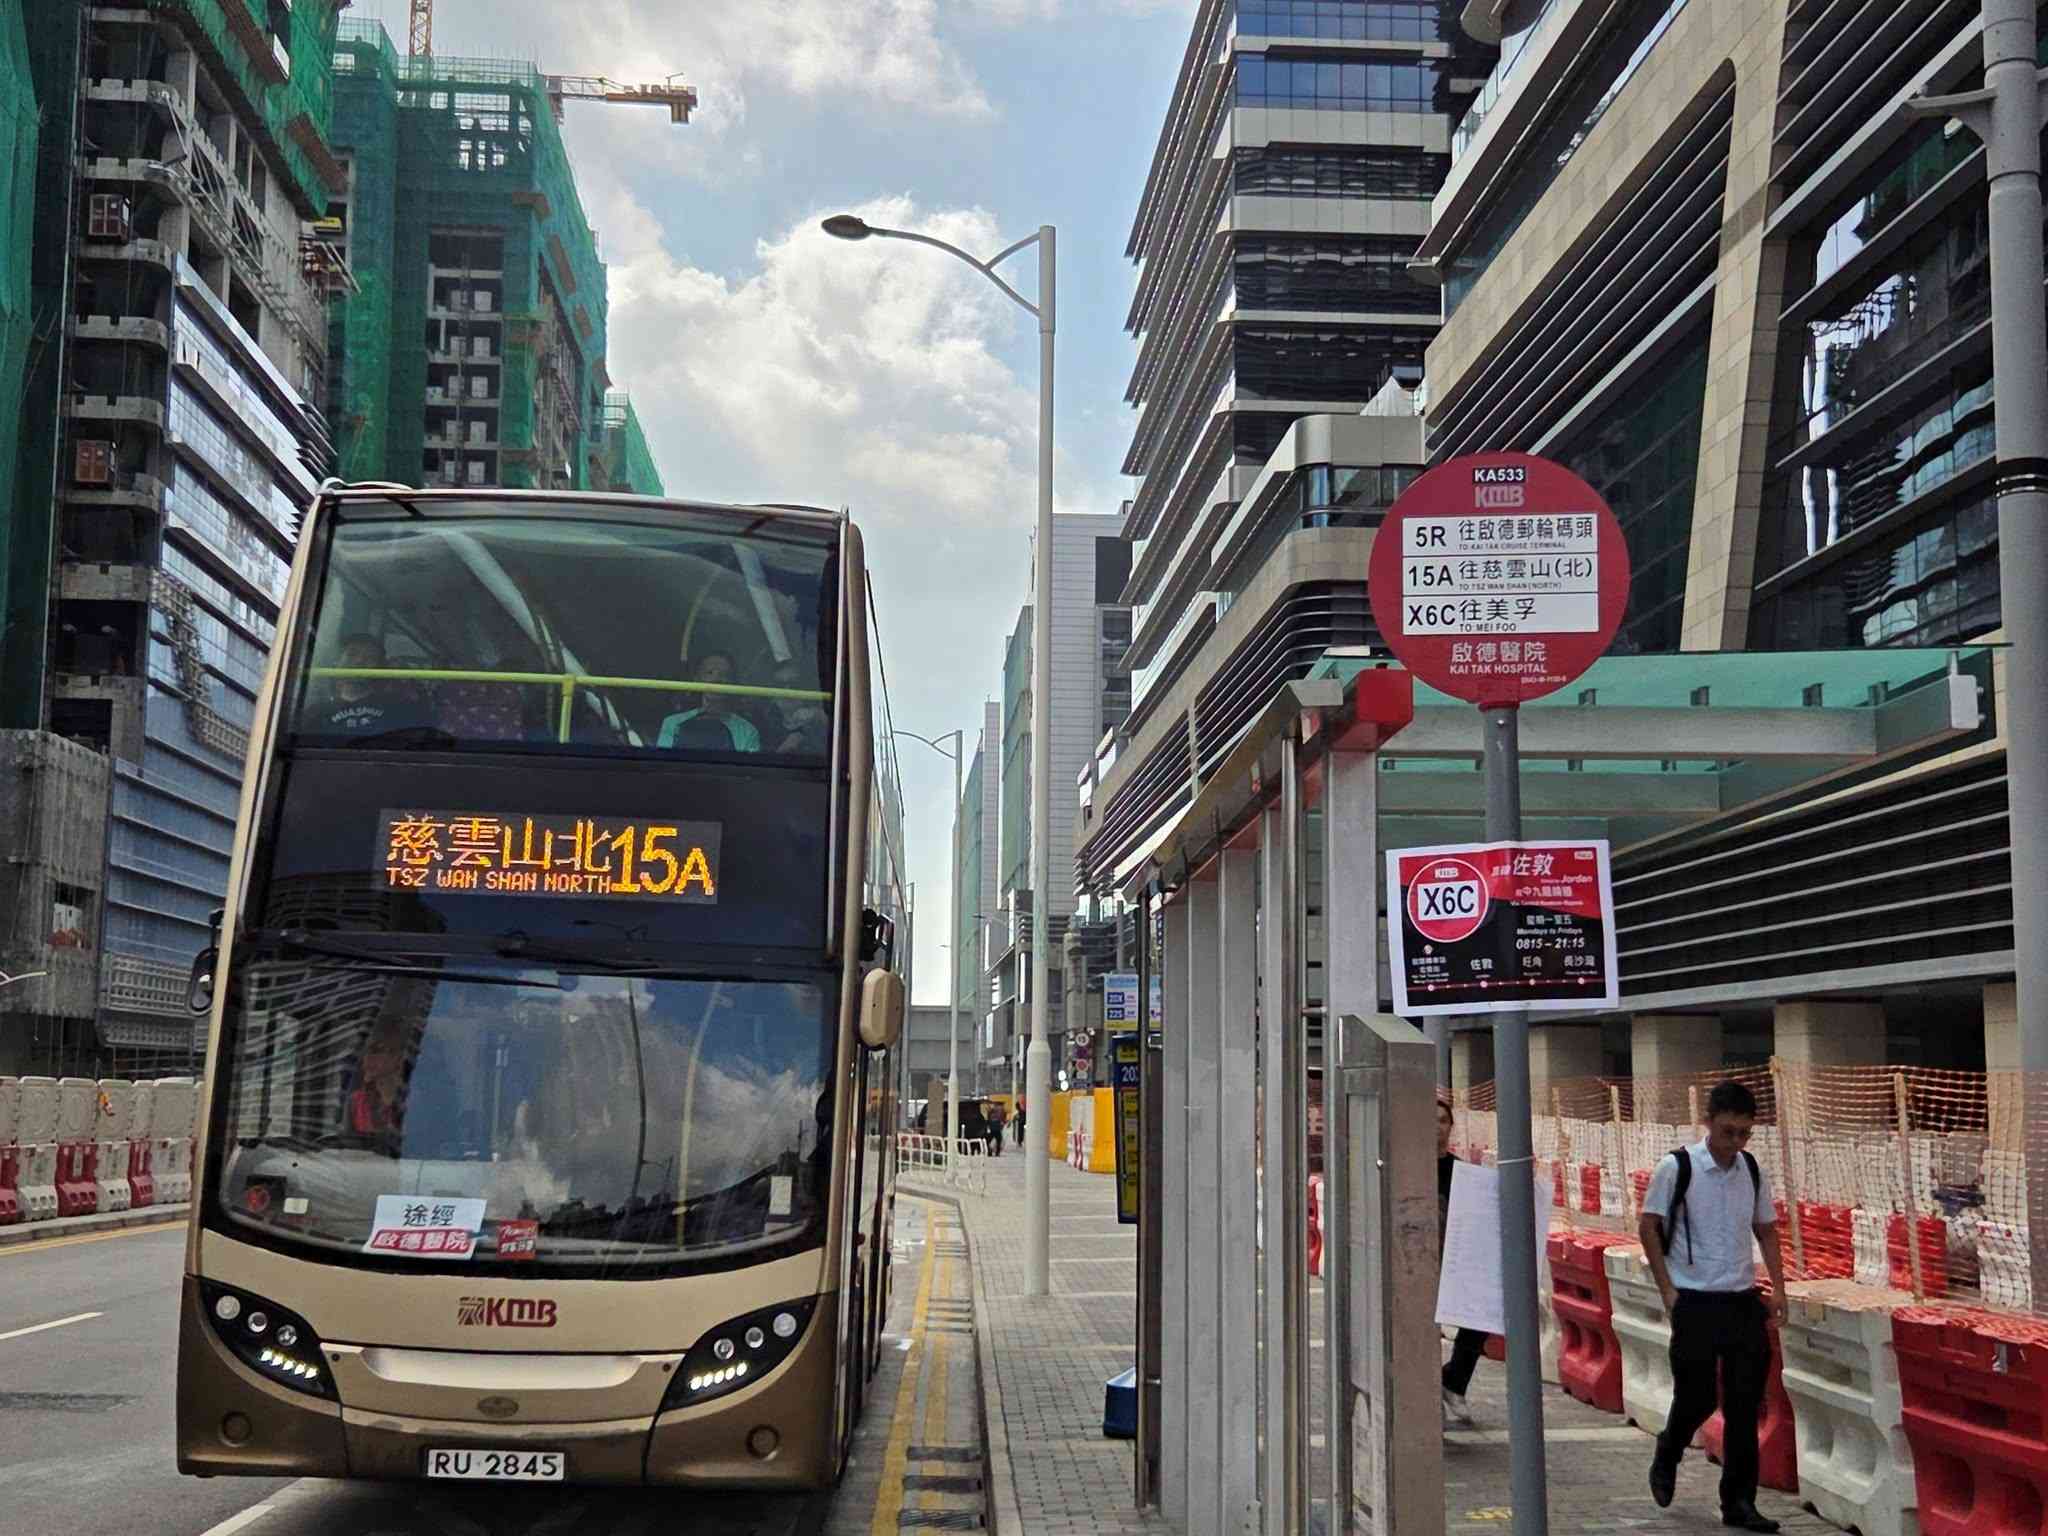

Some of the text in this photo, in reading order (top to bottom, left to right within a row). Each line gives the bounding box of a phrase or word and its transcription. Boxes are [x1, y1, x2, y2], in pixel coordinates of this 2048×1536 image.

[1474, 468, 1525, 482] KA533
[1474, 486, 1525, 508] KMB
[1415, 526, 1447, 548] 5R
[1458, 517, 1593, 541] 往啟德郵輪碼頭
[1408, 565, 1453, 587] 15A
[1458, 558, 1593, 580] 往慈雲山(北)
[1408, 604, 1456, 626] X6C
[1459, 598, 1537, 621] 往美孚
[1460, 623, 1517, 632] TO MEI FOO
[1452, 641, 1547, 662] 啟德醫院
[1450, 663, 1548, 674] KAI TAK HOSPITAL
[387, 812, 714, 895] 慈雲山北 15A
[1513, 854, 1554, 876] 佐敦
[386, 867, 612, 894] TSZ WAN SHAN NORTH
[1423, 886, 1475, 915] X6C
[1121, 1066, 1138, 1082] 20
[403, 1203, 456, 1226] 途經
[486, 1297, 557, 1328] KMB
[434, 1452, 559, 1476] RU 2845
